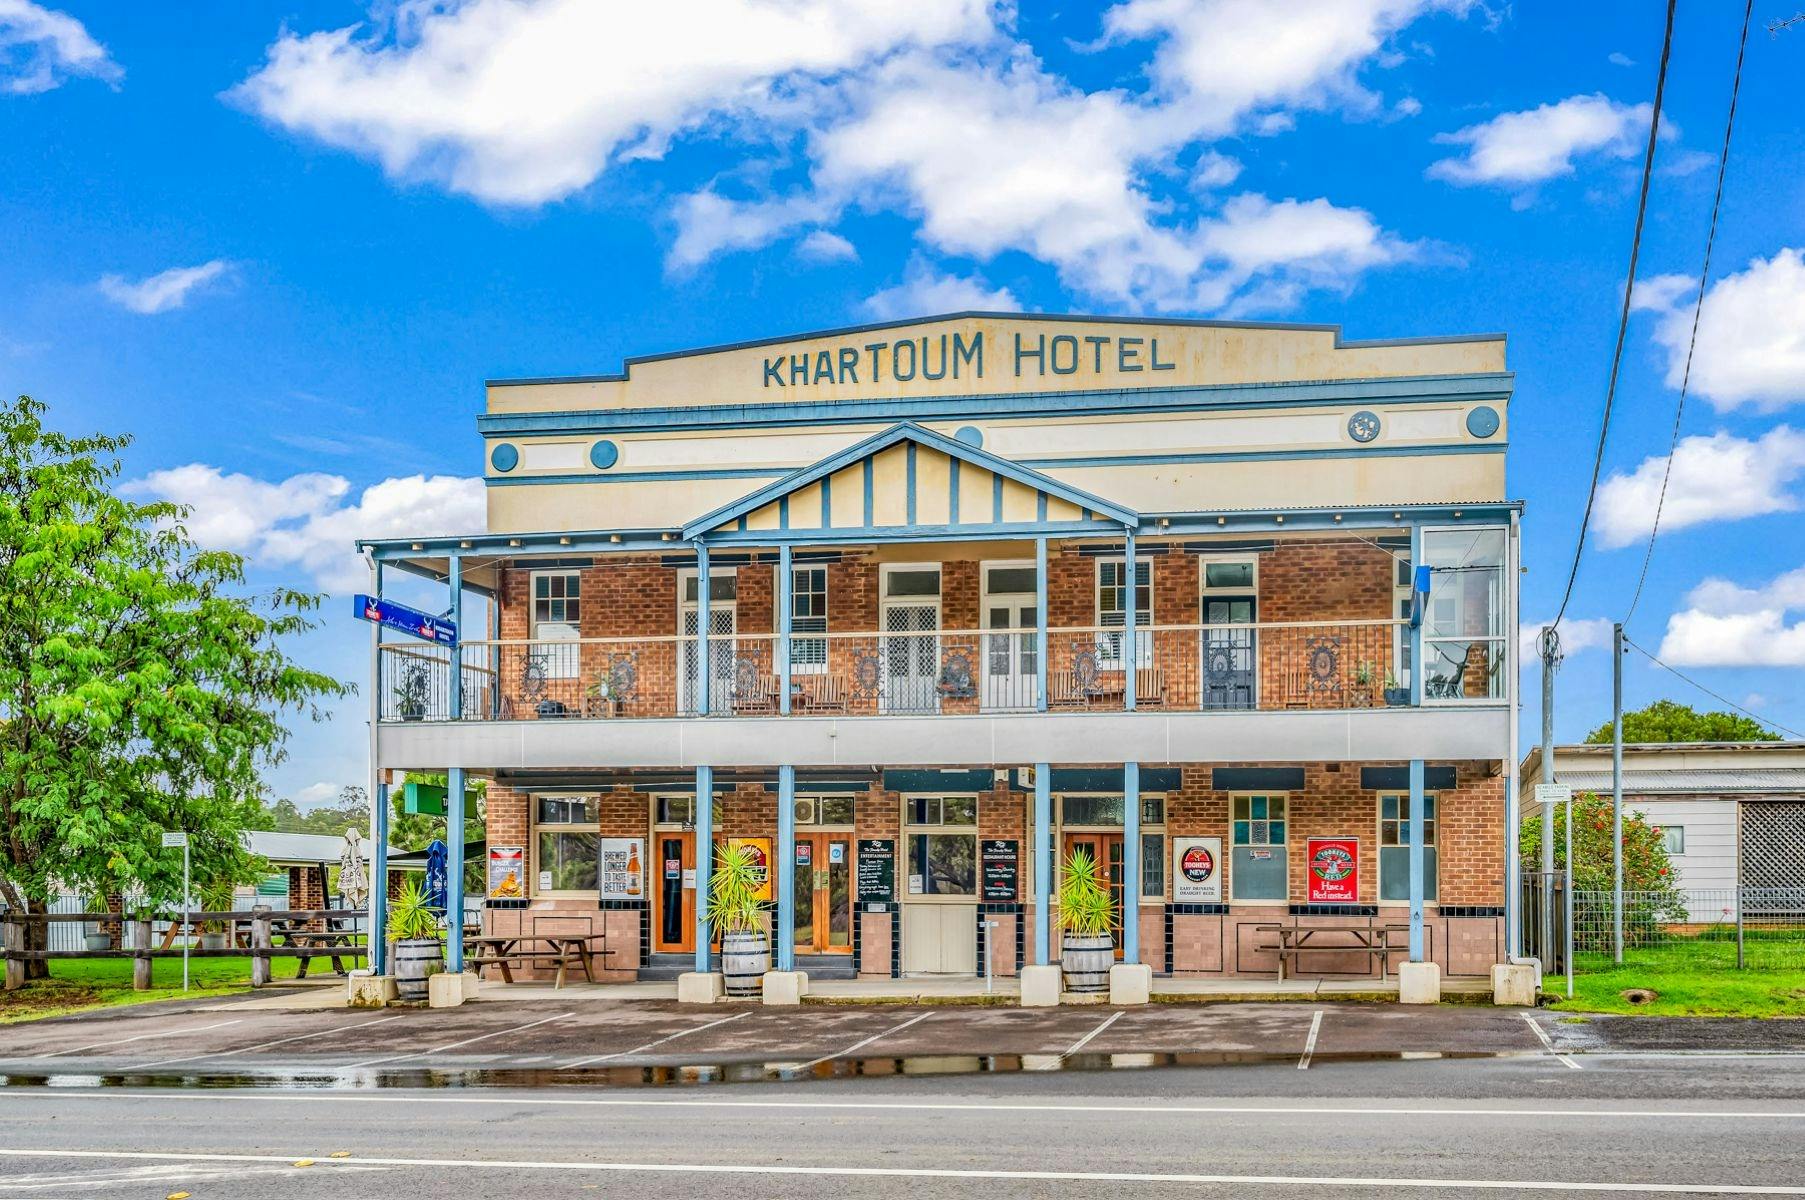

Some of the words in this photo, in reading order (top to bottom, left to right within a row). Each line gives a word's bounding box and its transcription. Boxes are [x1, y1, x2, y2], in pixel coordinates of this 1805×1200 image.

[764, 331, 983, 387] KHARTOUM
[1014, 332, 1176, 377] HOTEL
[604, 851, 627, 860] BREWED
[604, 862, 627, 872] LONGER
[604, 873, 611, 881] TO
[612, 873, 627, 881] TASTE
[604, 882, 627, 893] BETTER
[1321, 881, 1338, 891] Have
[1313, 890, 1327, 899] Red
